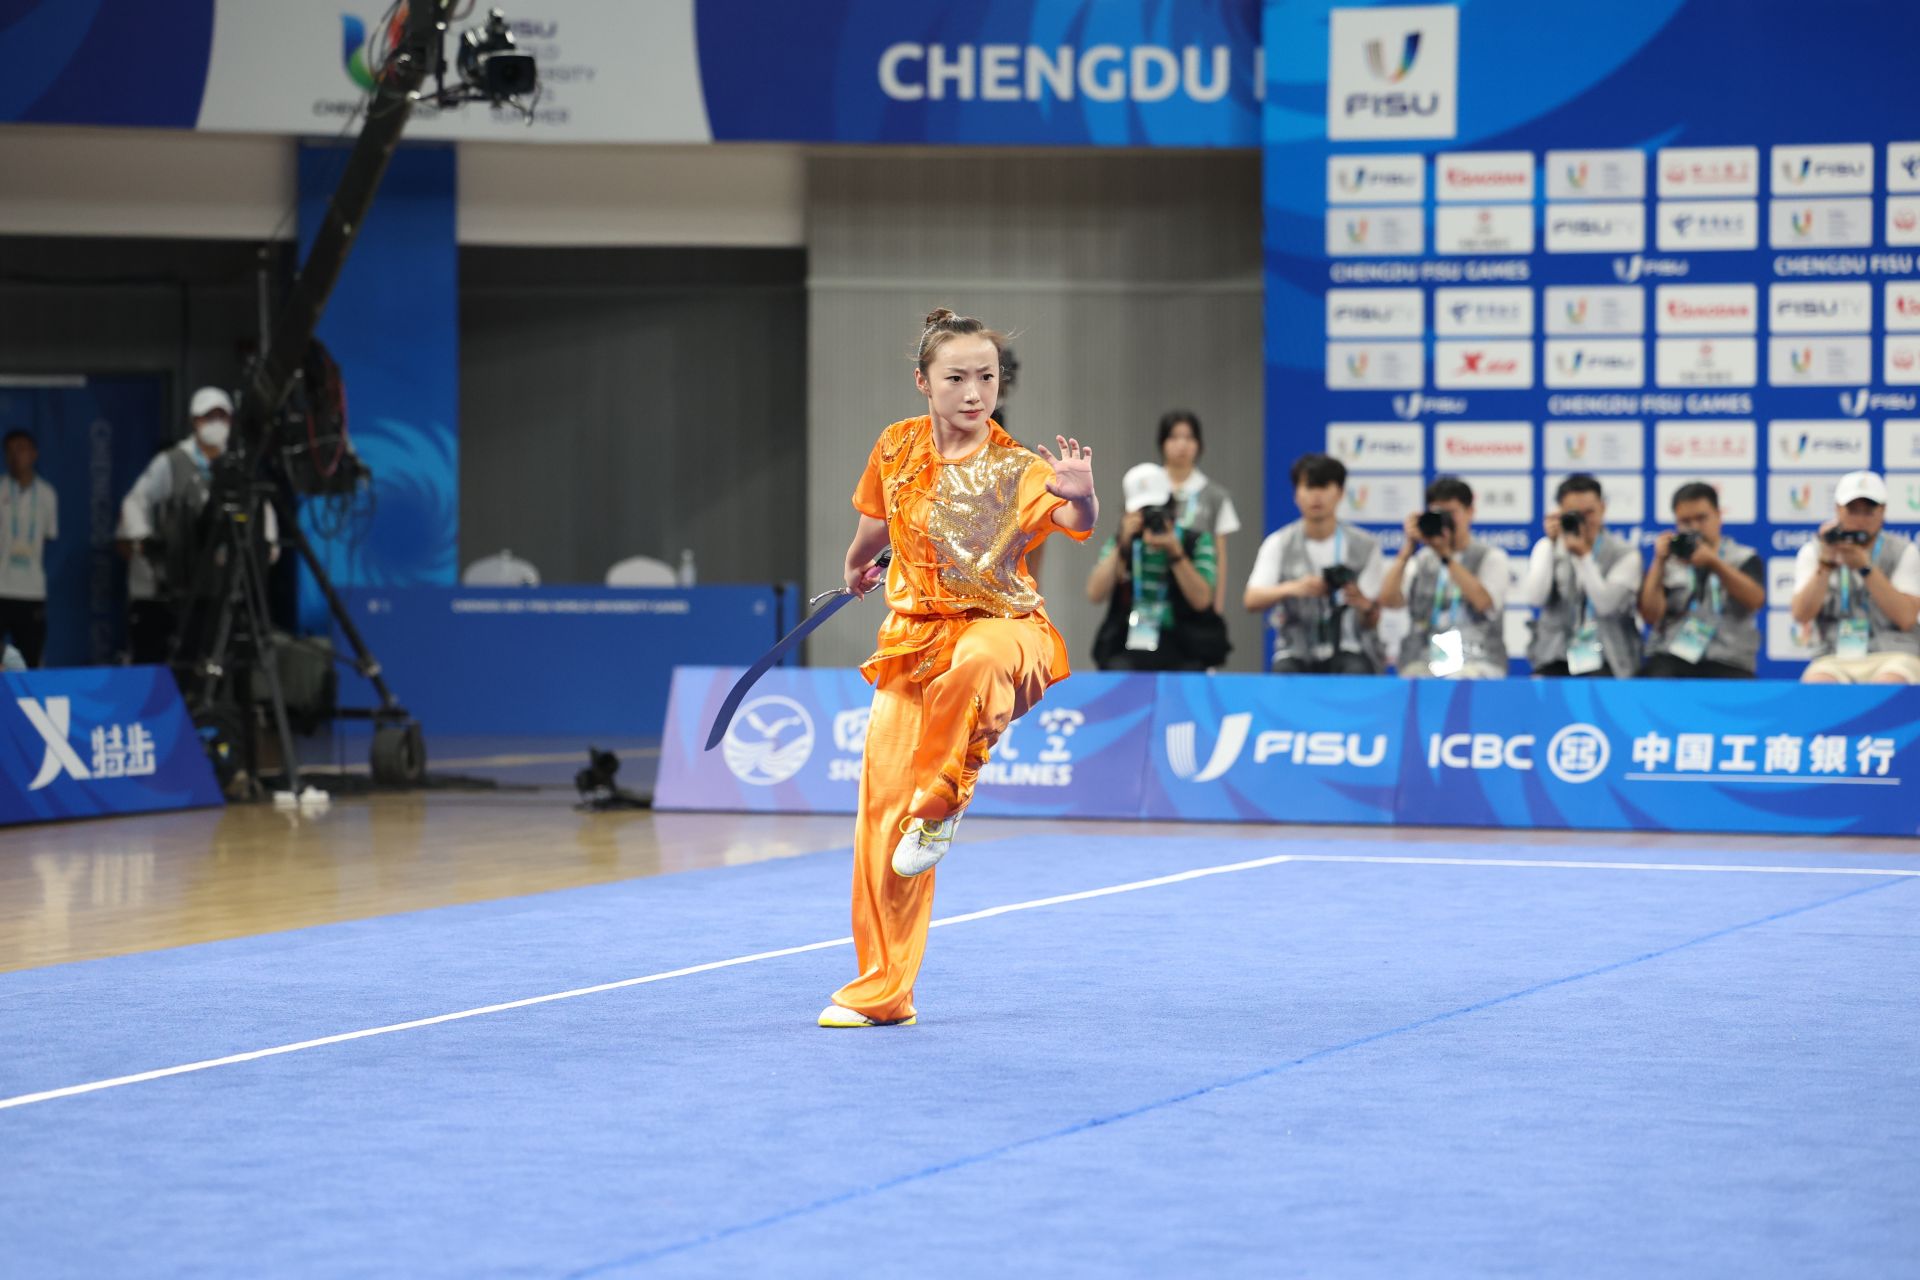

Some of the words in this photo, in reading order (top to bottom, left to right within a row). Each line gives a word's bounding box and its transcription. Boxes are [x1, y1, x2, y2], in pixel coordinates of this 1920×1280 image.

[878, 42, 1230, 101] CHENGDU
[1345, 91, 1439, 118] FISU
[1329, 261, 1418, 283] CHENGDU
[1420, 261, 1463, 282] FISU
[1464, 260, 1531, 281] GAMES
[1773, 255, 1868, 276] CHENGDU
[1870, 253, 1913, 274] FISU
[1547, 394, 1639, 415] CHENGDU
[1640, 394, 1684, 414] FISU
[1685, 393, 1753, 414] GAMES
[1869, 392, 1917, 411] FISU
[91, 722, 156, 779] 特步
[1253, 730, 1387, 767] FISU
[1427, 732, 1536, 770] ICBC
